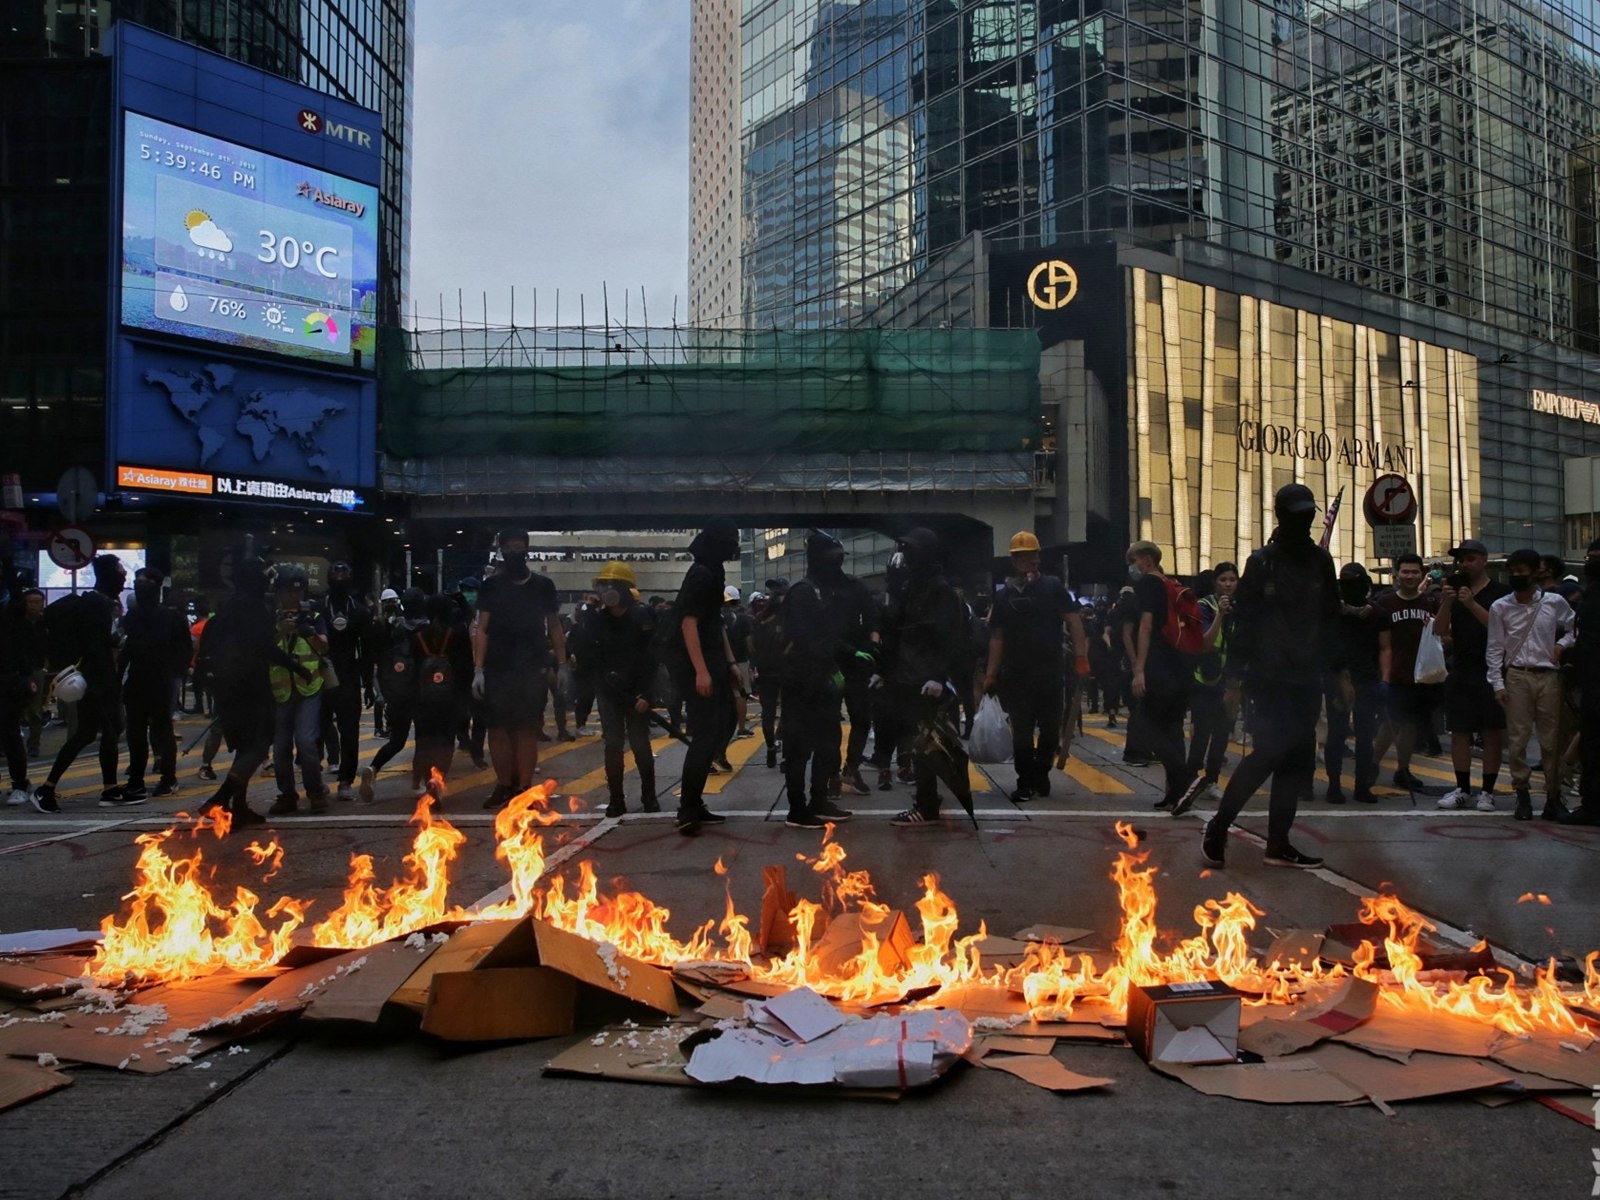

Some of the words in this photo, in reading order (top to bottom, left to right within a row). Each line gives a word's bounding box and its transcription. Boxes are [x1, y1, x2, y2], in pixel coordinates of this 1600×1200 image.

[326, 119, 371, 149] MTR
[140, 144, 221, 180] 5:39:46
[233, 171, 255, 190] PM
[314, 188, 365, 217] Asiaray
[257, 230, 338, 279] 30°C
[208, 296, 247, 319] 76%
[1533, 389, 1581, 419] EMPORIO
[1238, 419, 1332, 463] GIORGIO
[1337, 436, 1415, 474] ARMANI
[137, 473, 177, 489] Asiaray
[1391, 609, 1409, 623] OLD
